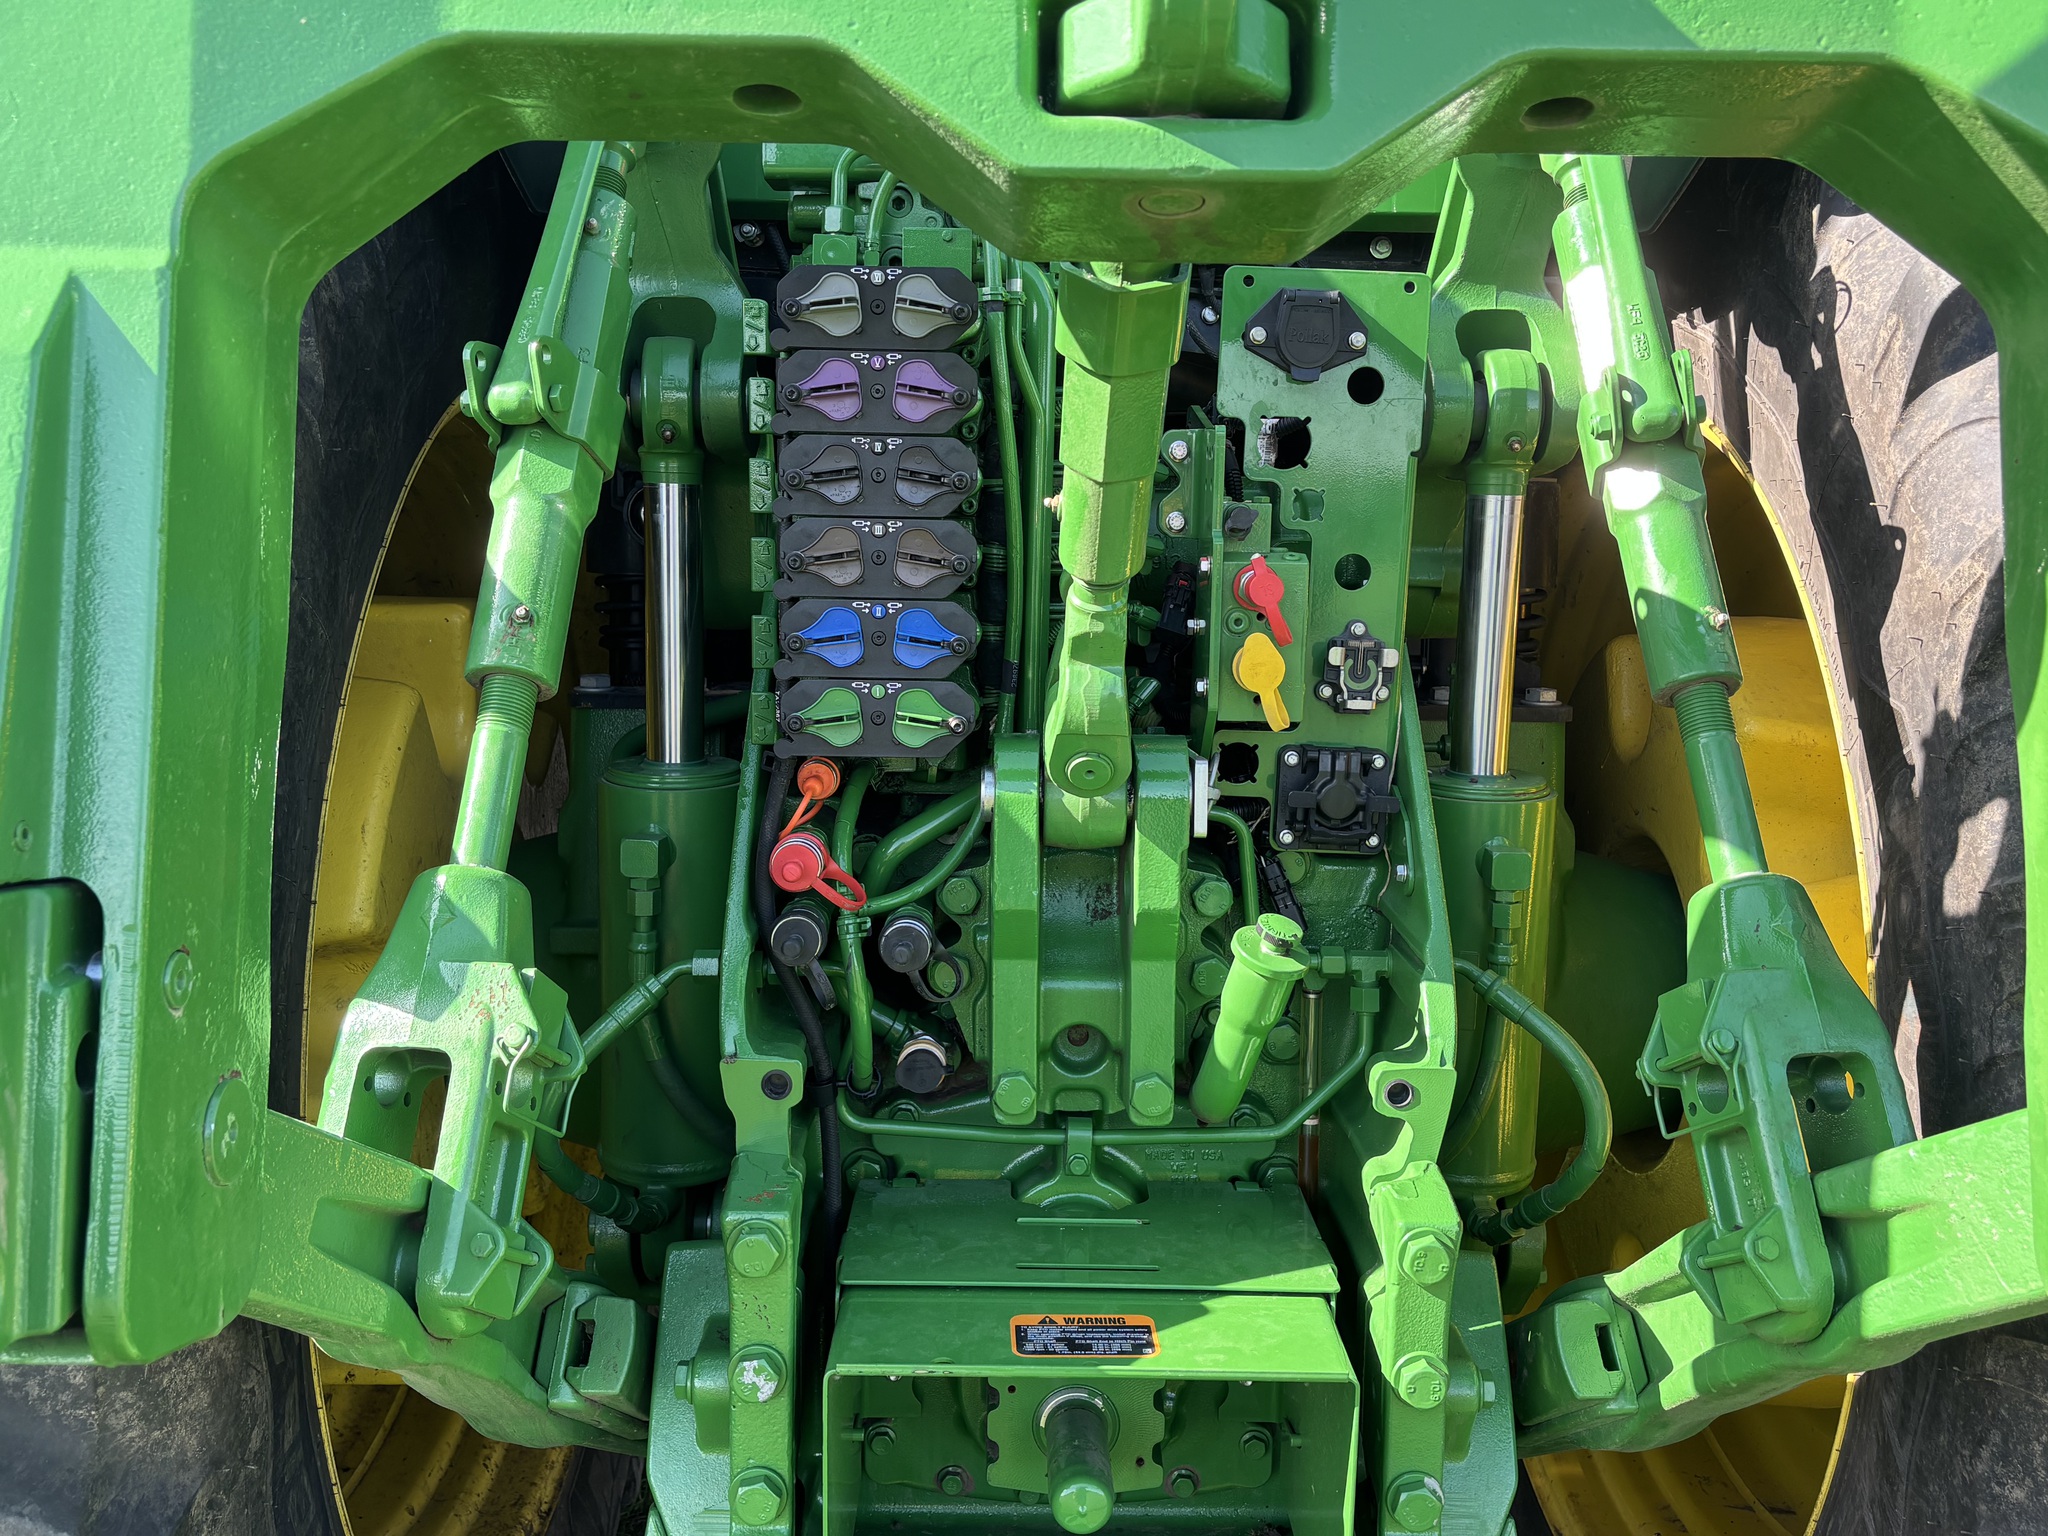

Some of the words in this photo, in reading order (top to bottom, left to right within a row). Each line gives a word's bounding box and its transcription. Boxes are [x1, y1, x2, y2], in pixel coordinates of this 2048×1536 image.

[1288, 327, 1329, 345] Pollak
[874, 358, 882, 367] V
[947, 881, 966, 895] 10.9
[1145, 1148, 1175, 1160] MADE
[1180, 1148, 1195, 1161] IN
[1201, 1149, 1224, 1161] USA
[742, 1262, 765, 1274] 10.9
[1413, 1251, 1428, 1273] 10.9
[1063, 1317, 1126, 1325] WARNING
[1430, 1380, 1441, 1402] 10.9
